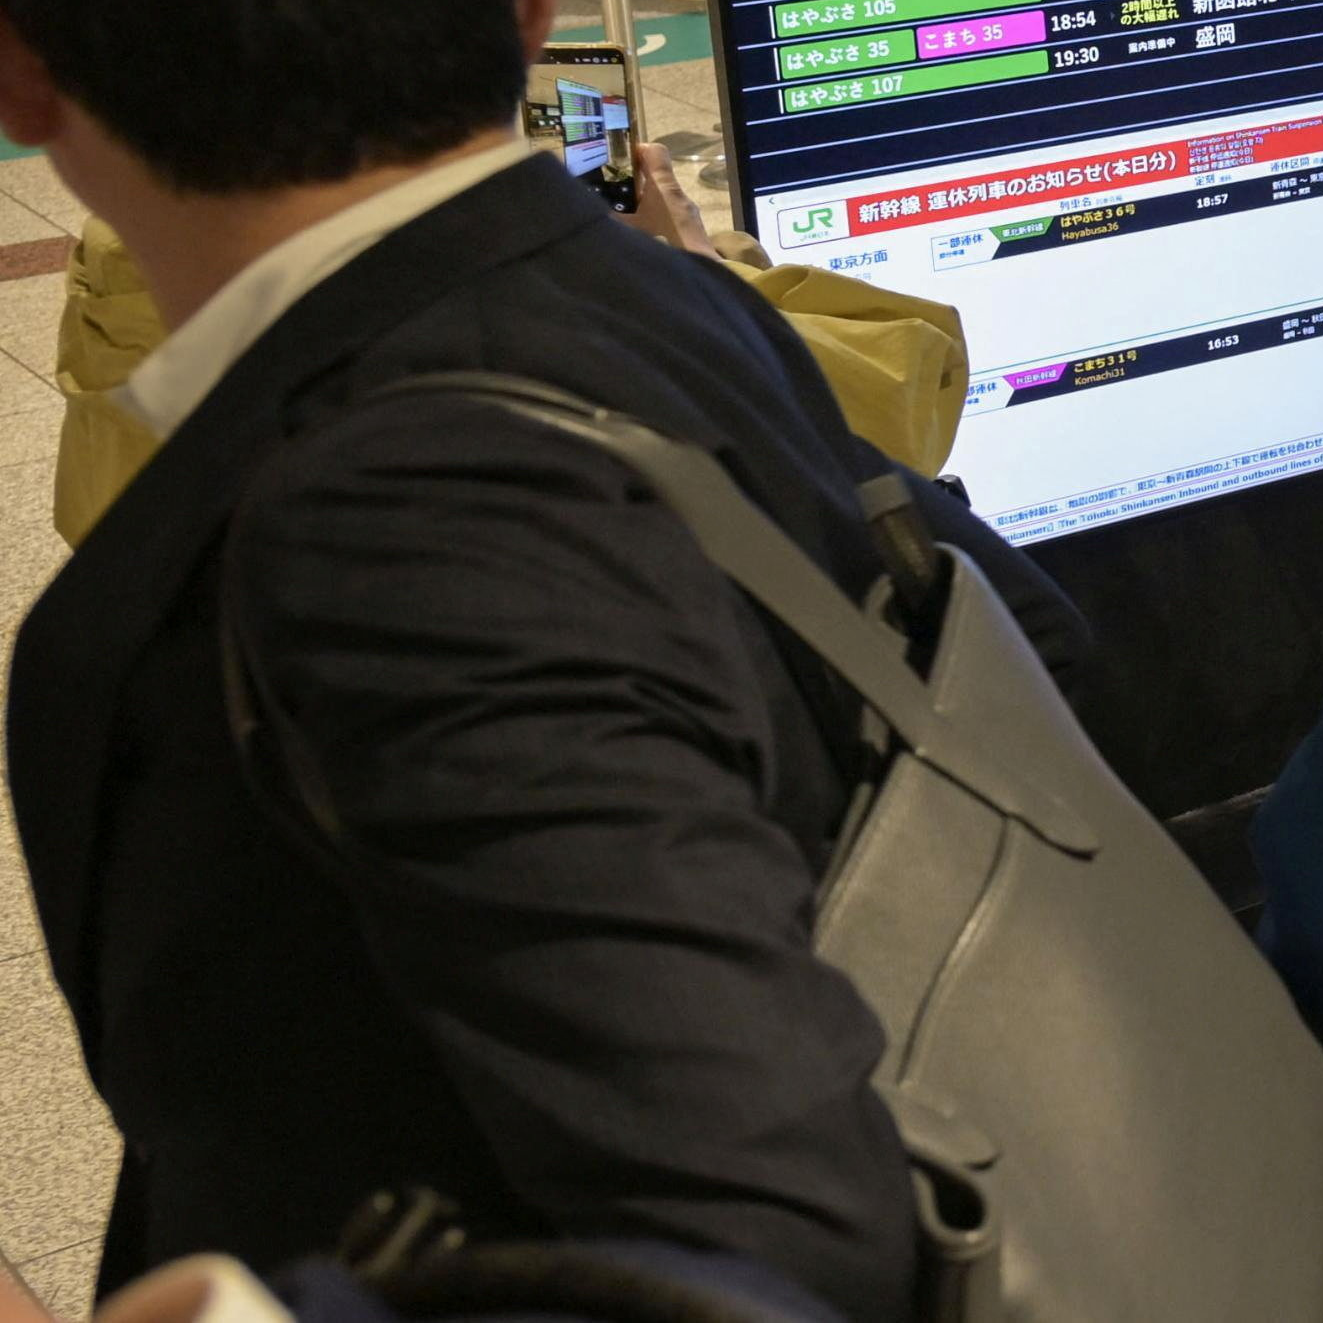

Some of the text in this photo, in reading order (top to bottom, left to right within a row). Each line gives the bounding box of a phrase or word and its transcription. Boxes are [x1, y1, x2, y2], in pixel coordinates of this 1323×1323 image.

[859, 196, 922, 224] 新幹線
[1060, 196, 1092, 211] 列車名
[1197, 194, 1228, 208] 18:57
[793, 207, 834, 234] JR
[1061, 222, 1119, 241] Hayabusa36
[1207, 334, 1240, 351] 16:53
